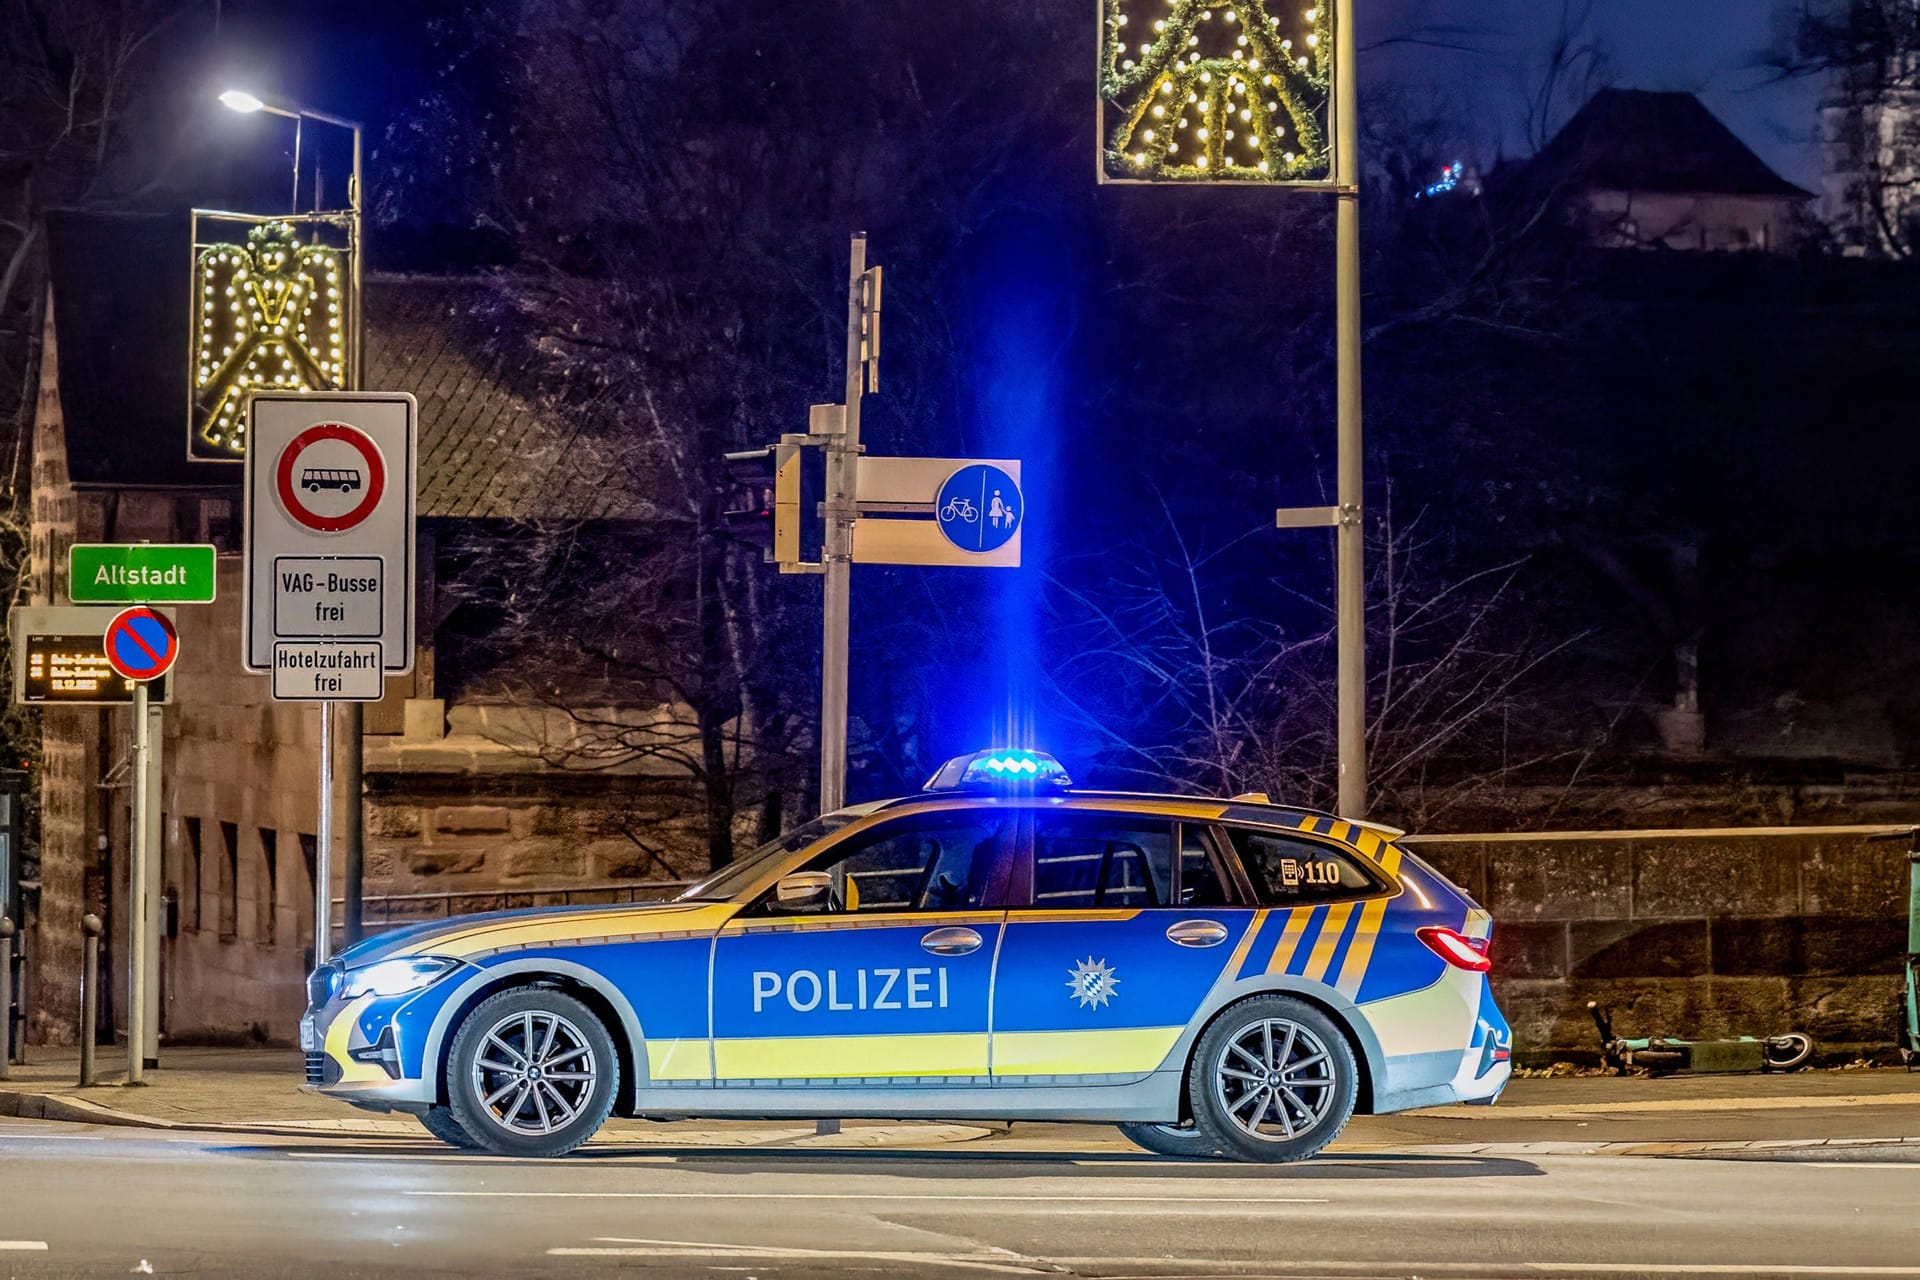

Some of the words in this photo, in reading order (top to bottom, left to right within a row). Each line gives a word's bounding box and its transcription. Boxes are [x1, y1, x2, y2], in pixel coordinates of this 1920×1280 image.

[94, 564, 187, 585] Altstadt
[282, 572, 377, 593] VAG-Busse
[315, 601, 344, 621] frei
[278, 650, 376, 669] Hotelzufahrt
[314, 673, 342, 692] frei
[1304, 861, 1340, 884] 110
[752, 967, 948, 1013] POLIZEI
